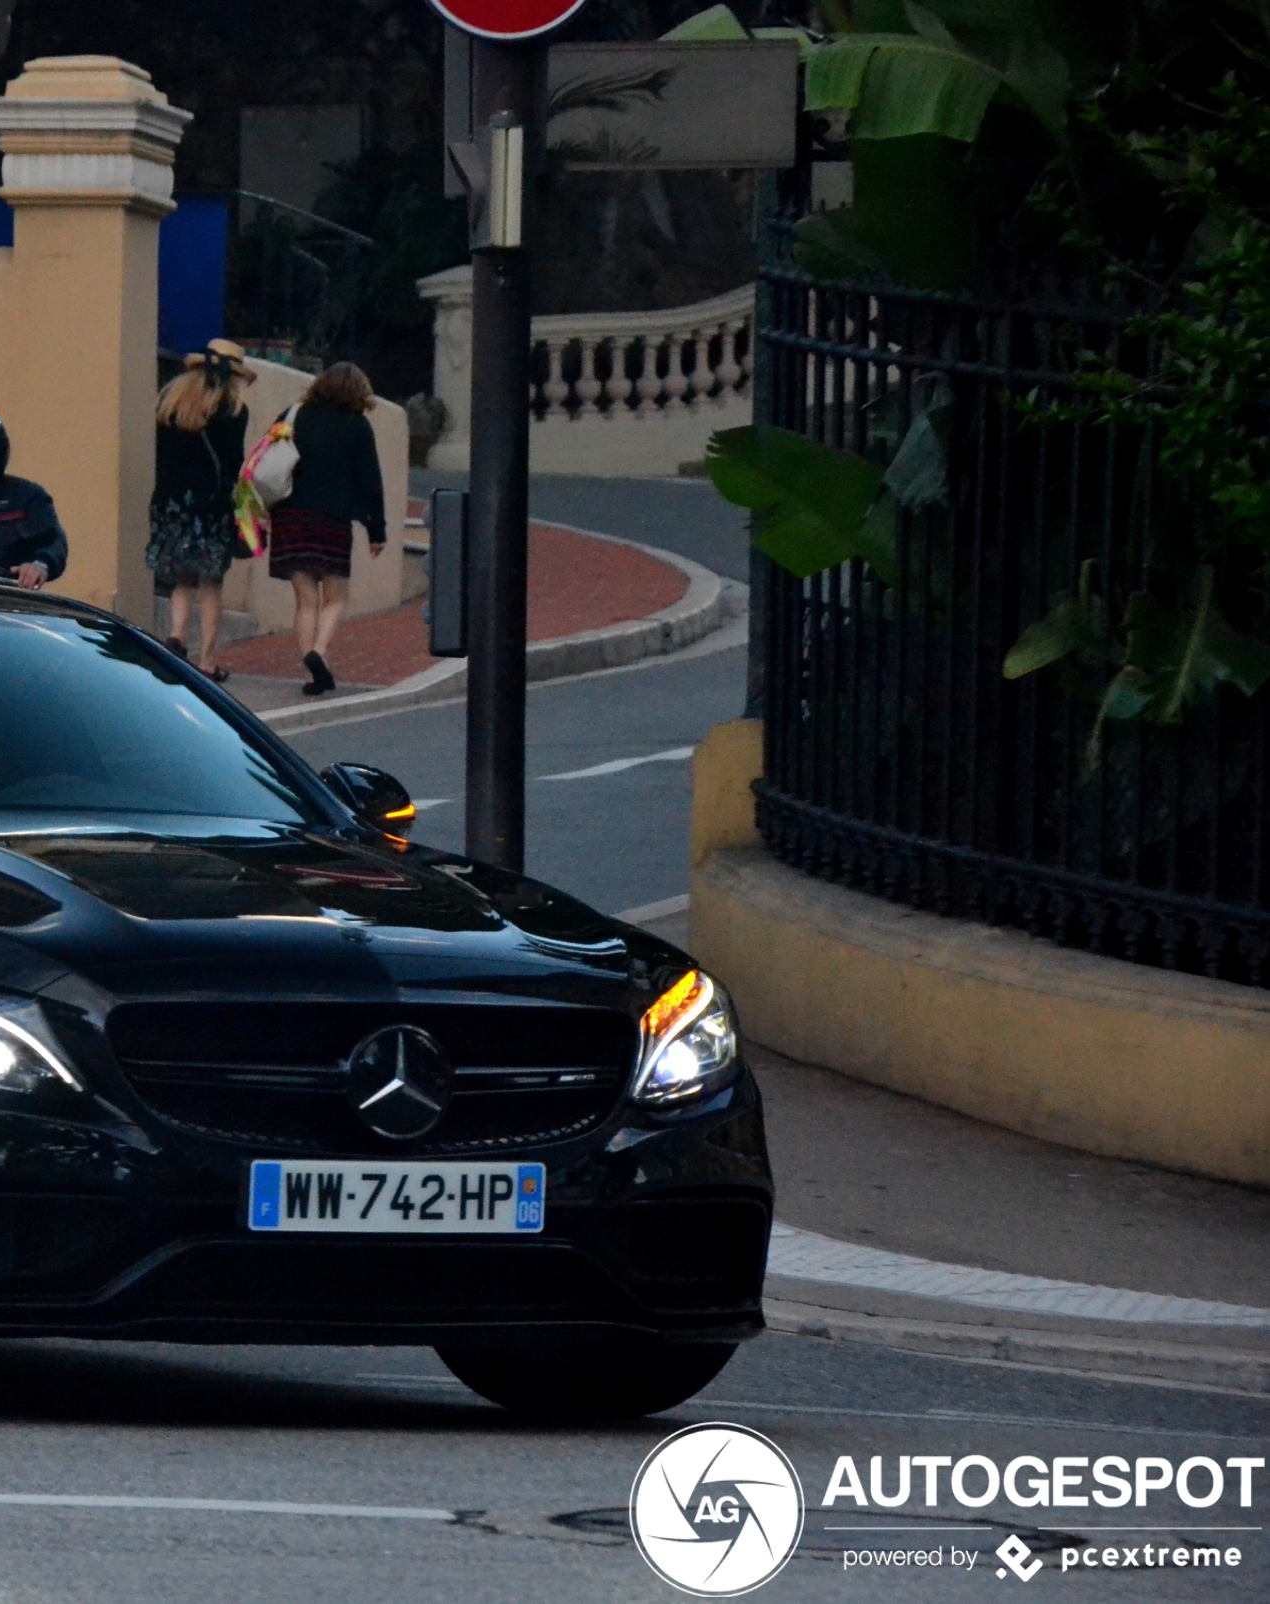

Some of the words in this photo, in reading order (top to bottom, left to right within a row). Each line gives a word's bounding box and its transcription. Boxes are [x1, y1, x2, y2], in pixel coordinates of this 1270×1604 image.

[286, 1172, 514, 1220] WW-742-HP
[261, 1202, 272, 1217] F
[518, 1200, 540, 1223] 06
